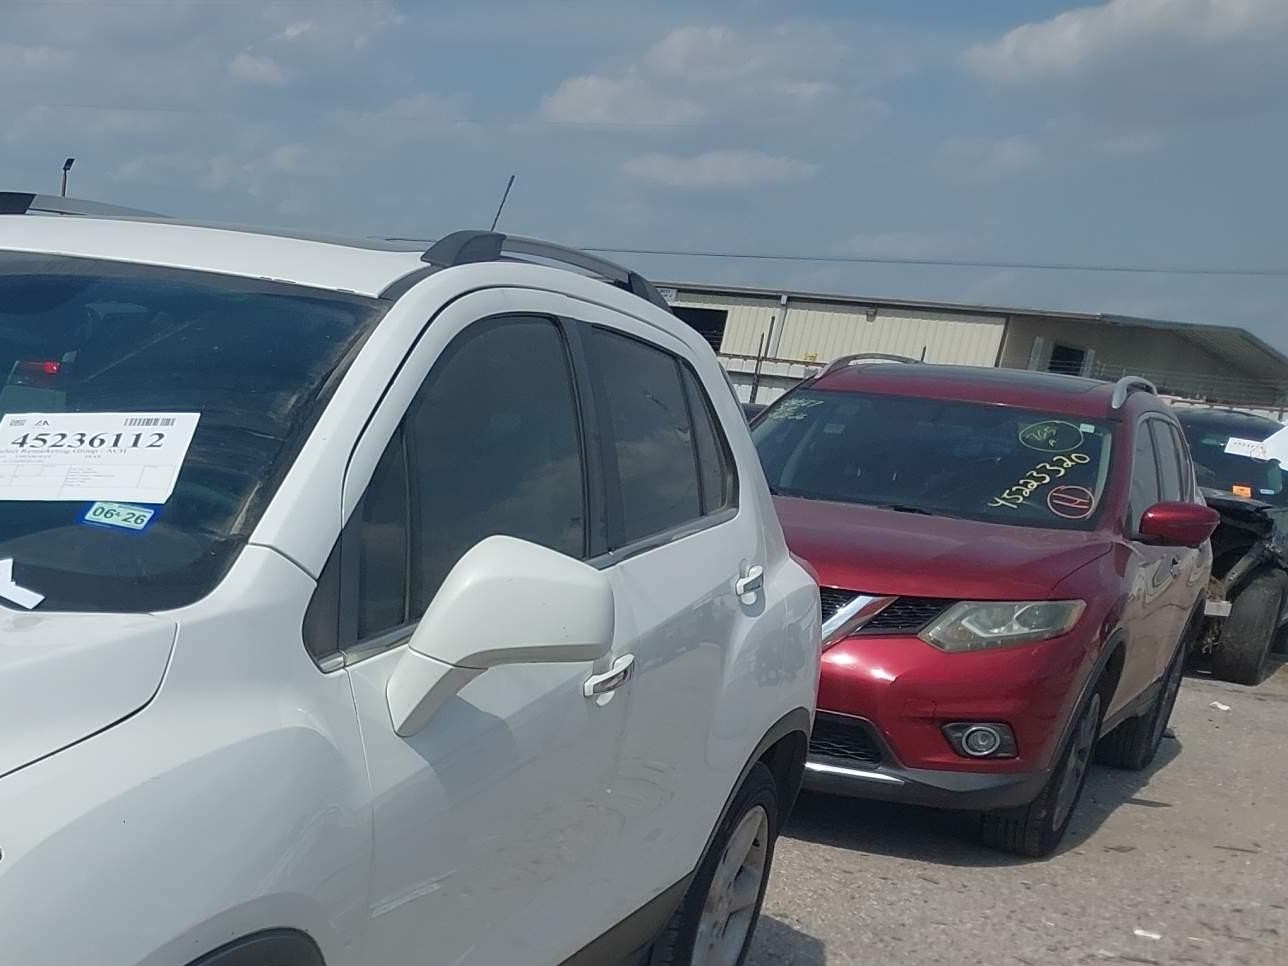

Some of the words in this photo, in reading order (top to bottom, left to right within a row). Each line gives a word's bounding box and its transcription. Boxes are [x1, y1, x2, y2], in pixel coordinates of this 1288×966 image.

[11, 432, 165, 448] 45236112
[987, 453, 1091, 509] 45223320
[92, 506, 116, 519] 06
[121, 512, 147, 525] 26
